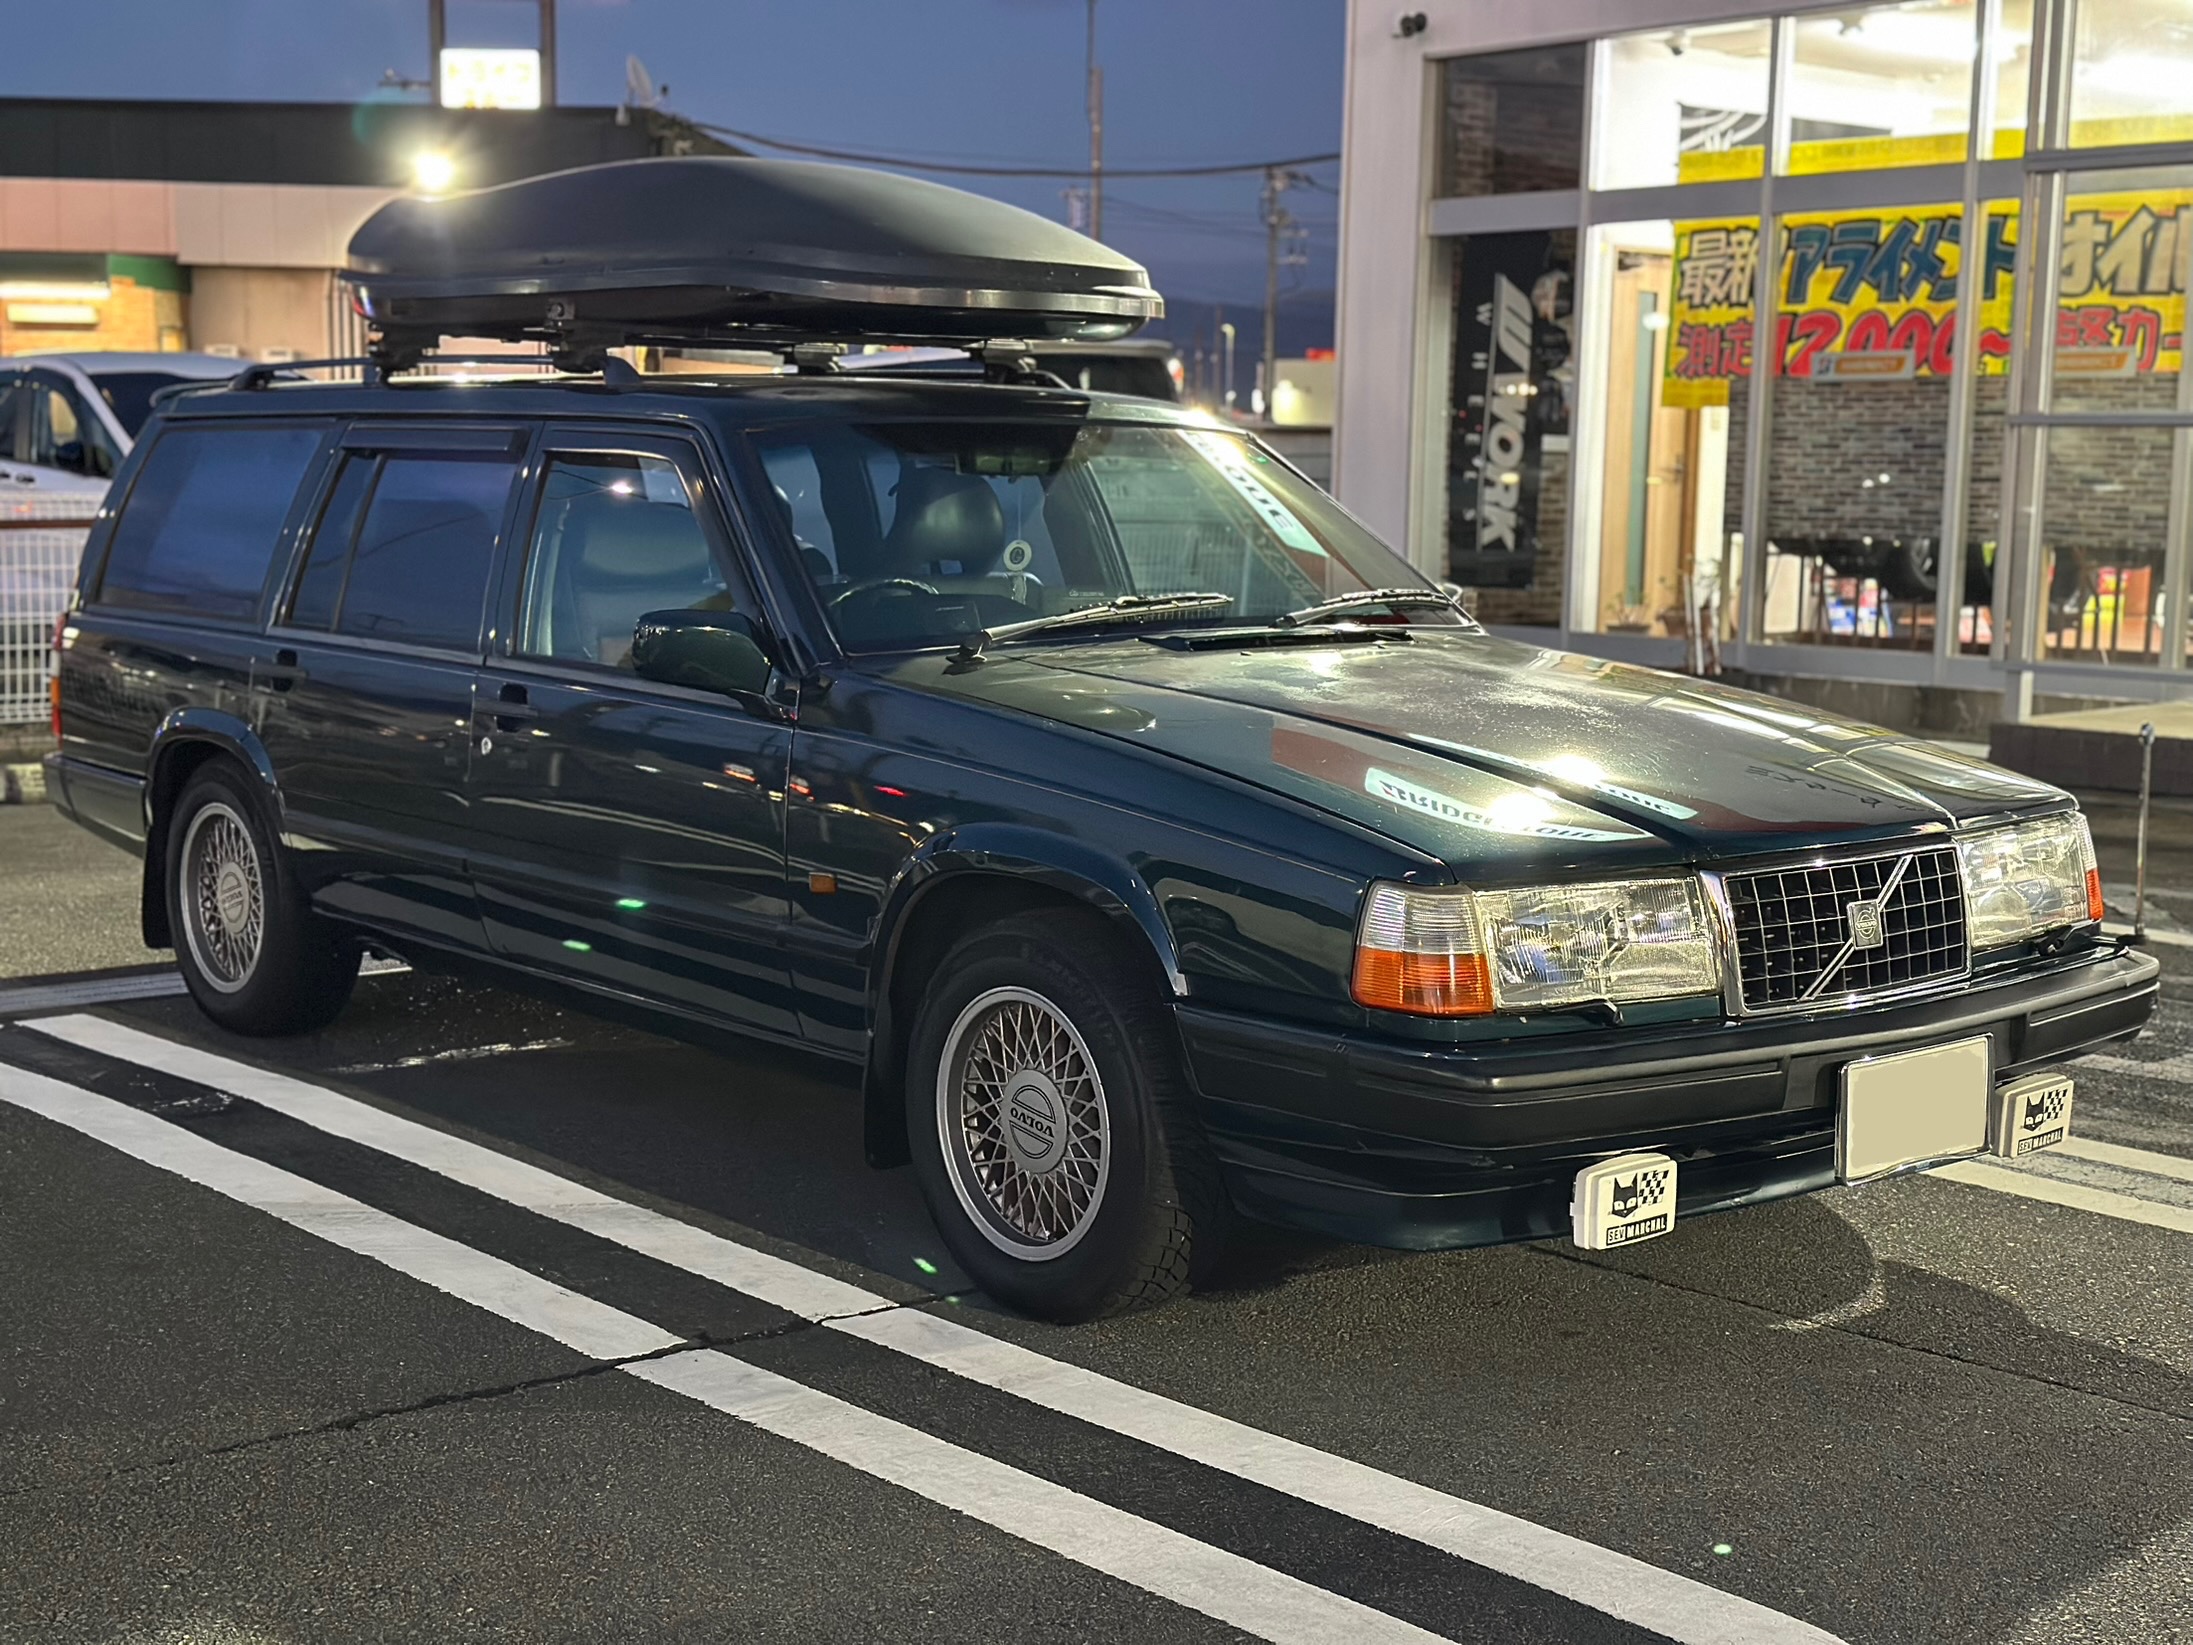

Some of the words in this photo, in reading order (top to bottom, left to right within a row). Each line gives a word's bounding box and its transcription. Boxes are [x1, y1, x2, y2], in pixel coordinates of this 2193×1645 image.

[1010, 1107, 1054, 1138] VOLVO
[1608, 1226, 1625, 1242] SEV
[1626, 1216, 1666, 1239] MARCHAL
